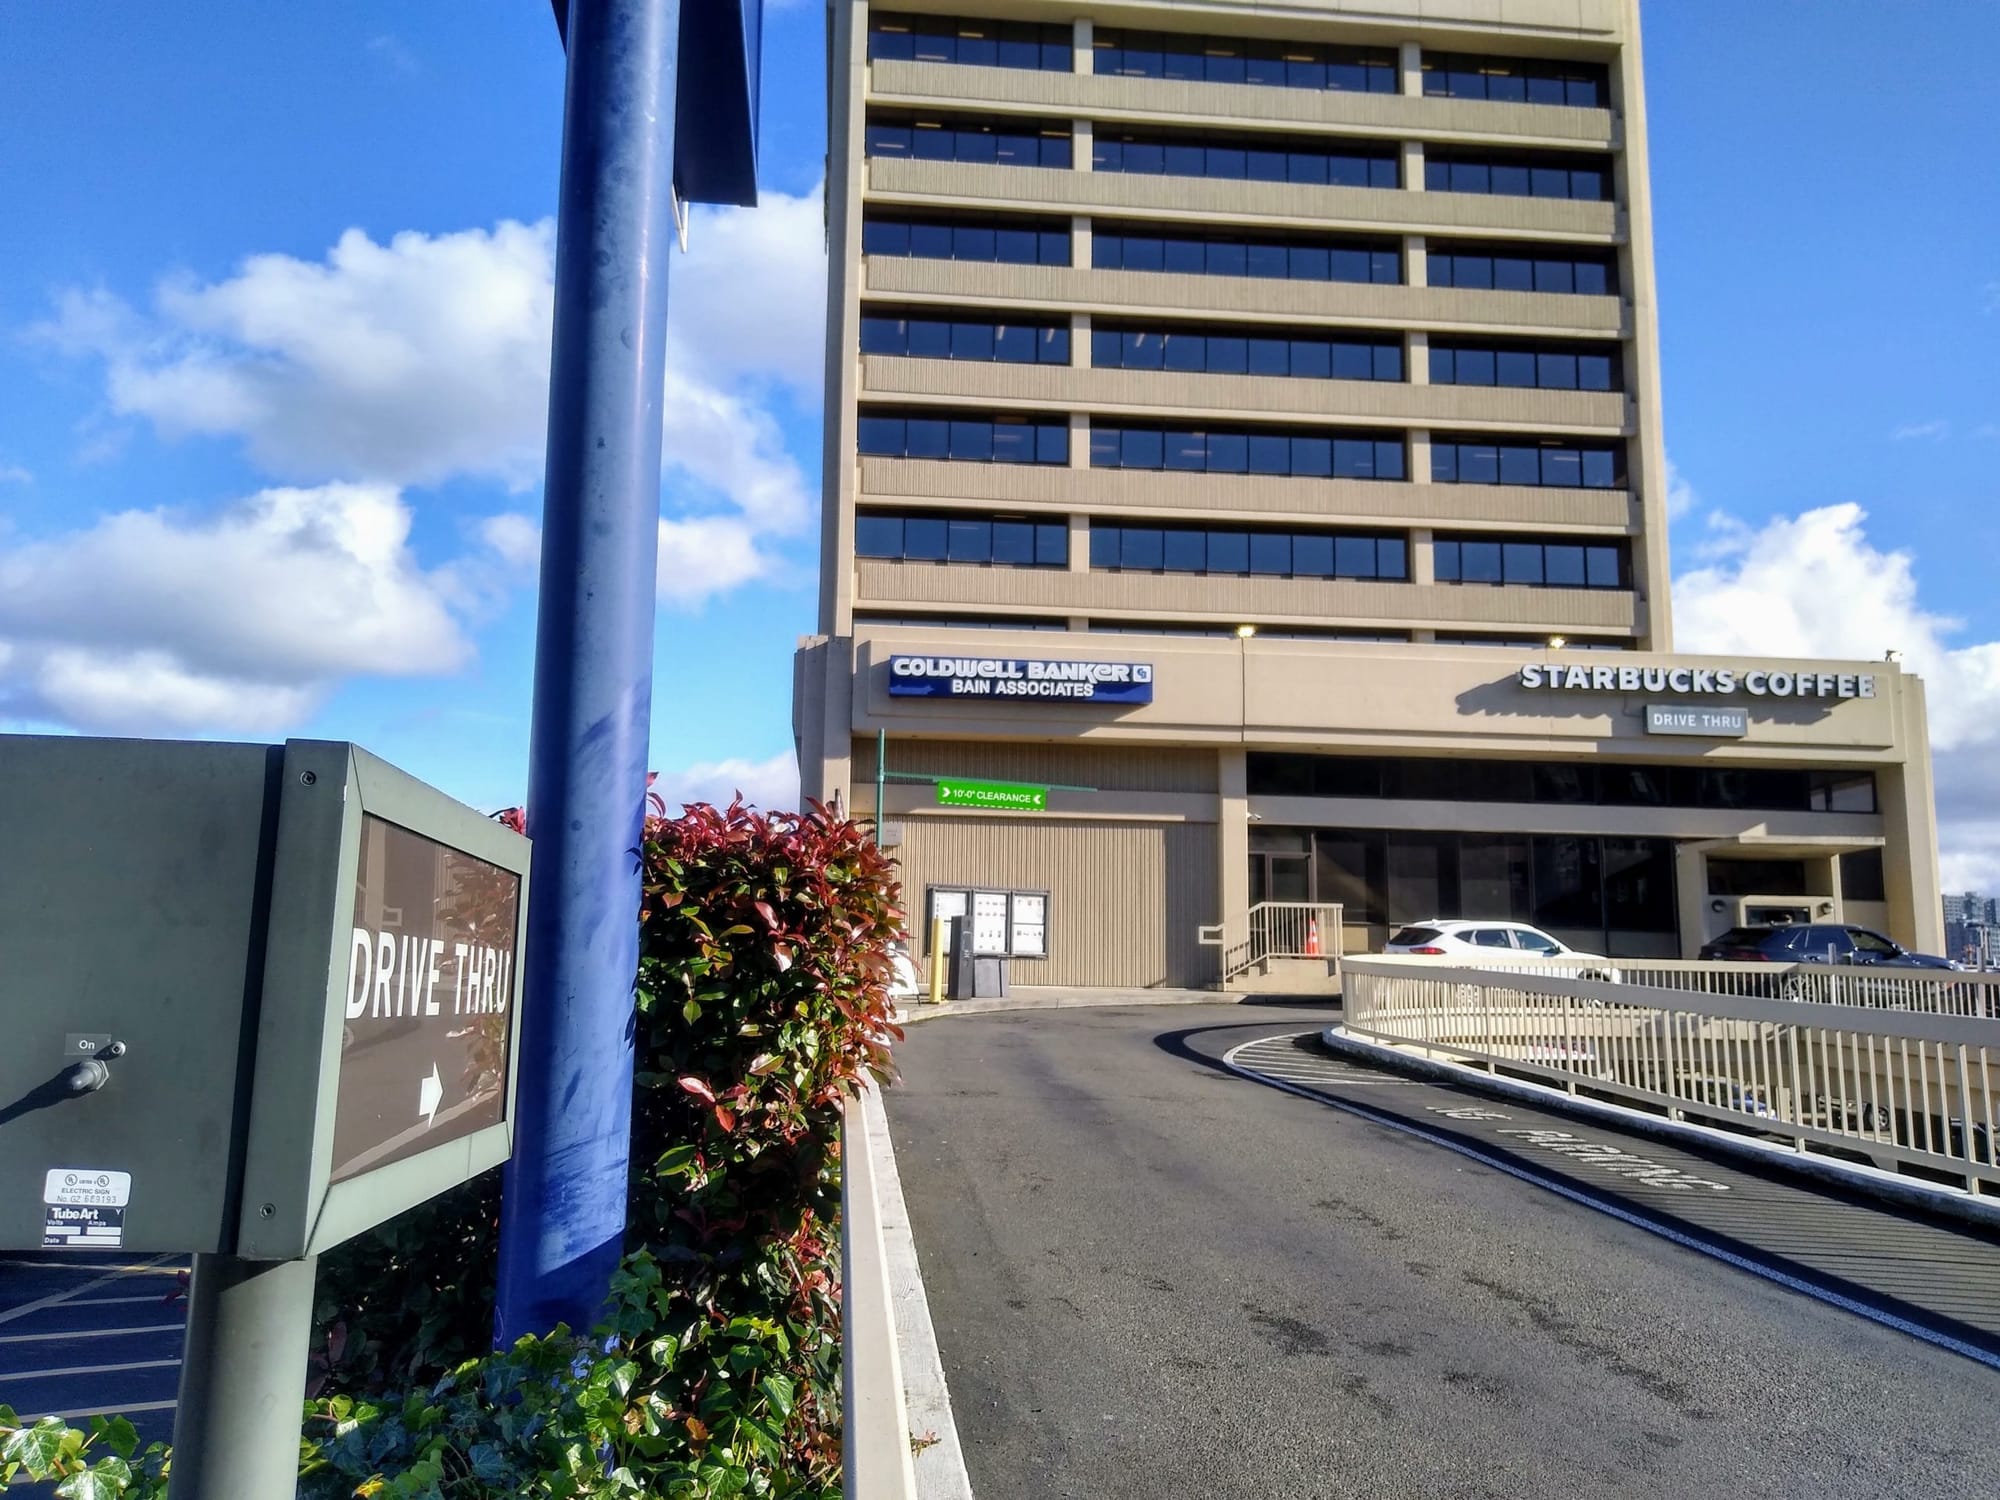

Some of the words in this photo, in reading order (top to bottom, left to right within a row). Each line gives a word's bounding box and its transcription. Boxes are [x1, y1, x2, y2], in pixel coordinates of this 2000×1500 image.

[893, 658, 1024, 679] COLDWELL
[1027, 662, 1130, 684] BANKER
[952, 679, 990, 694] BAIN
[995, 681, 1094, 697] ASSOCIATES
[1520, 664, 1736, 693] STARBUCKS
[1744, 671, 1875, 698] COFFEE
[1653, 712, 1697, 728] DRIVE
[1701, 714, 1742, 729] THRU
[976, 791, 1031, 803] CLEARANCE
[346, 928, 444, 1019] DRIVE
[455, 943, 511, 1015] THRU
[79, 1040, 95, 1050] On
[61, 1187, 93, 1195] ELECTRIC
